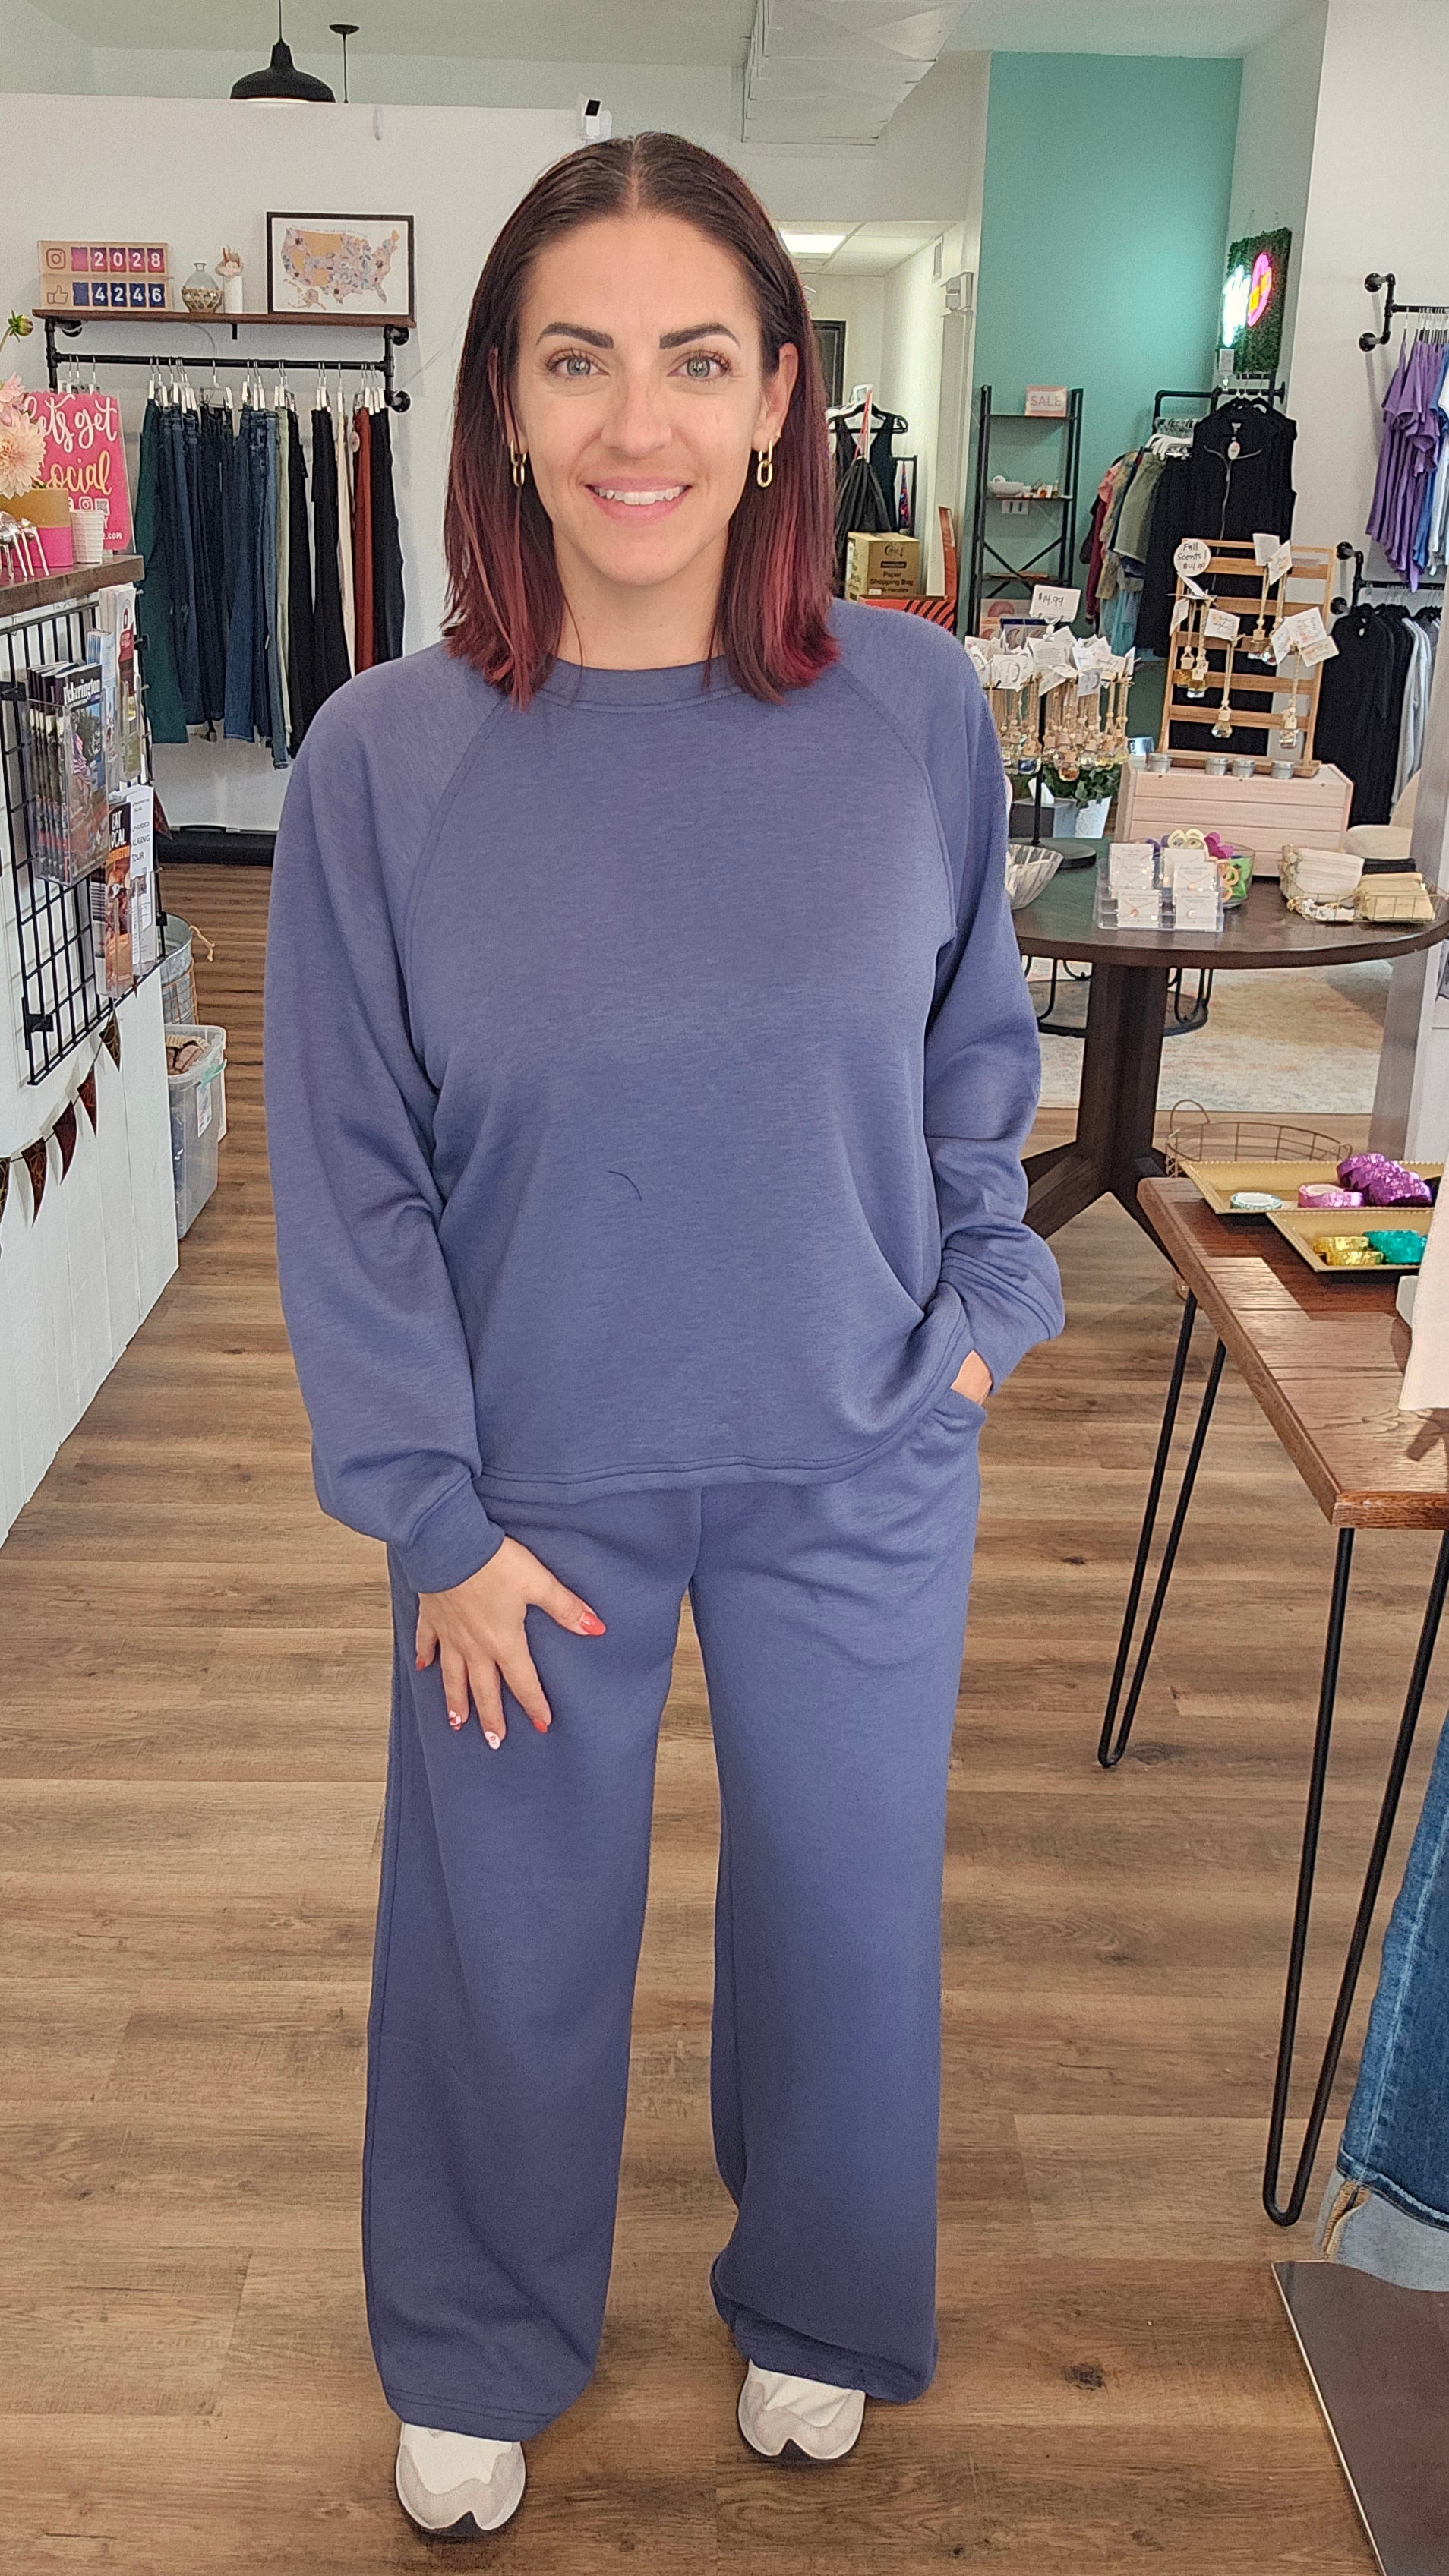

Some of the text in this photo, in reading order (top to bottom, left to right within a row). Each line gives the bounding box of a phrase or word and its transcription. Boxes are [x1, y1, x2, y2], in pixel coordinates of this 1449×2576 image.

[93, 251, 161, 267] 2028
[95, 287, 163, 302] 4246
[1031, 395, 1062, 407] SALE
[74, 396, 118, 450] get
[47, 450, 112, 495] ocial
[1182, 542, 1198, 551] Fall
[112, 810, 122, 831] EAT
[112, 827, 127, 848] OCAL
